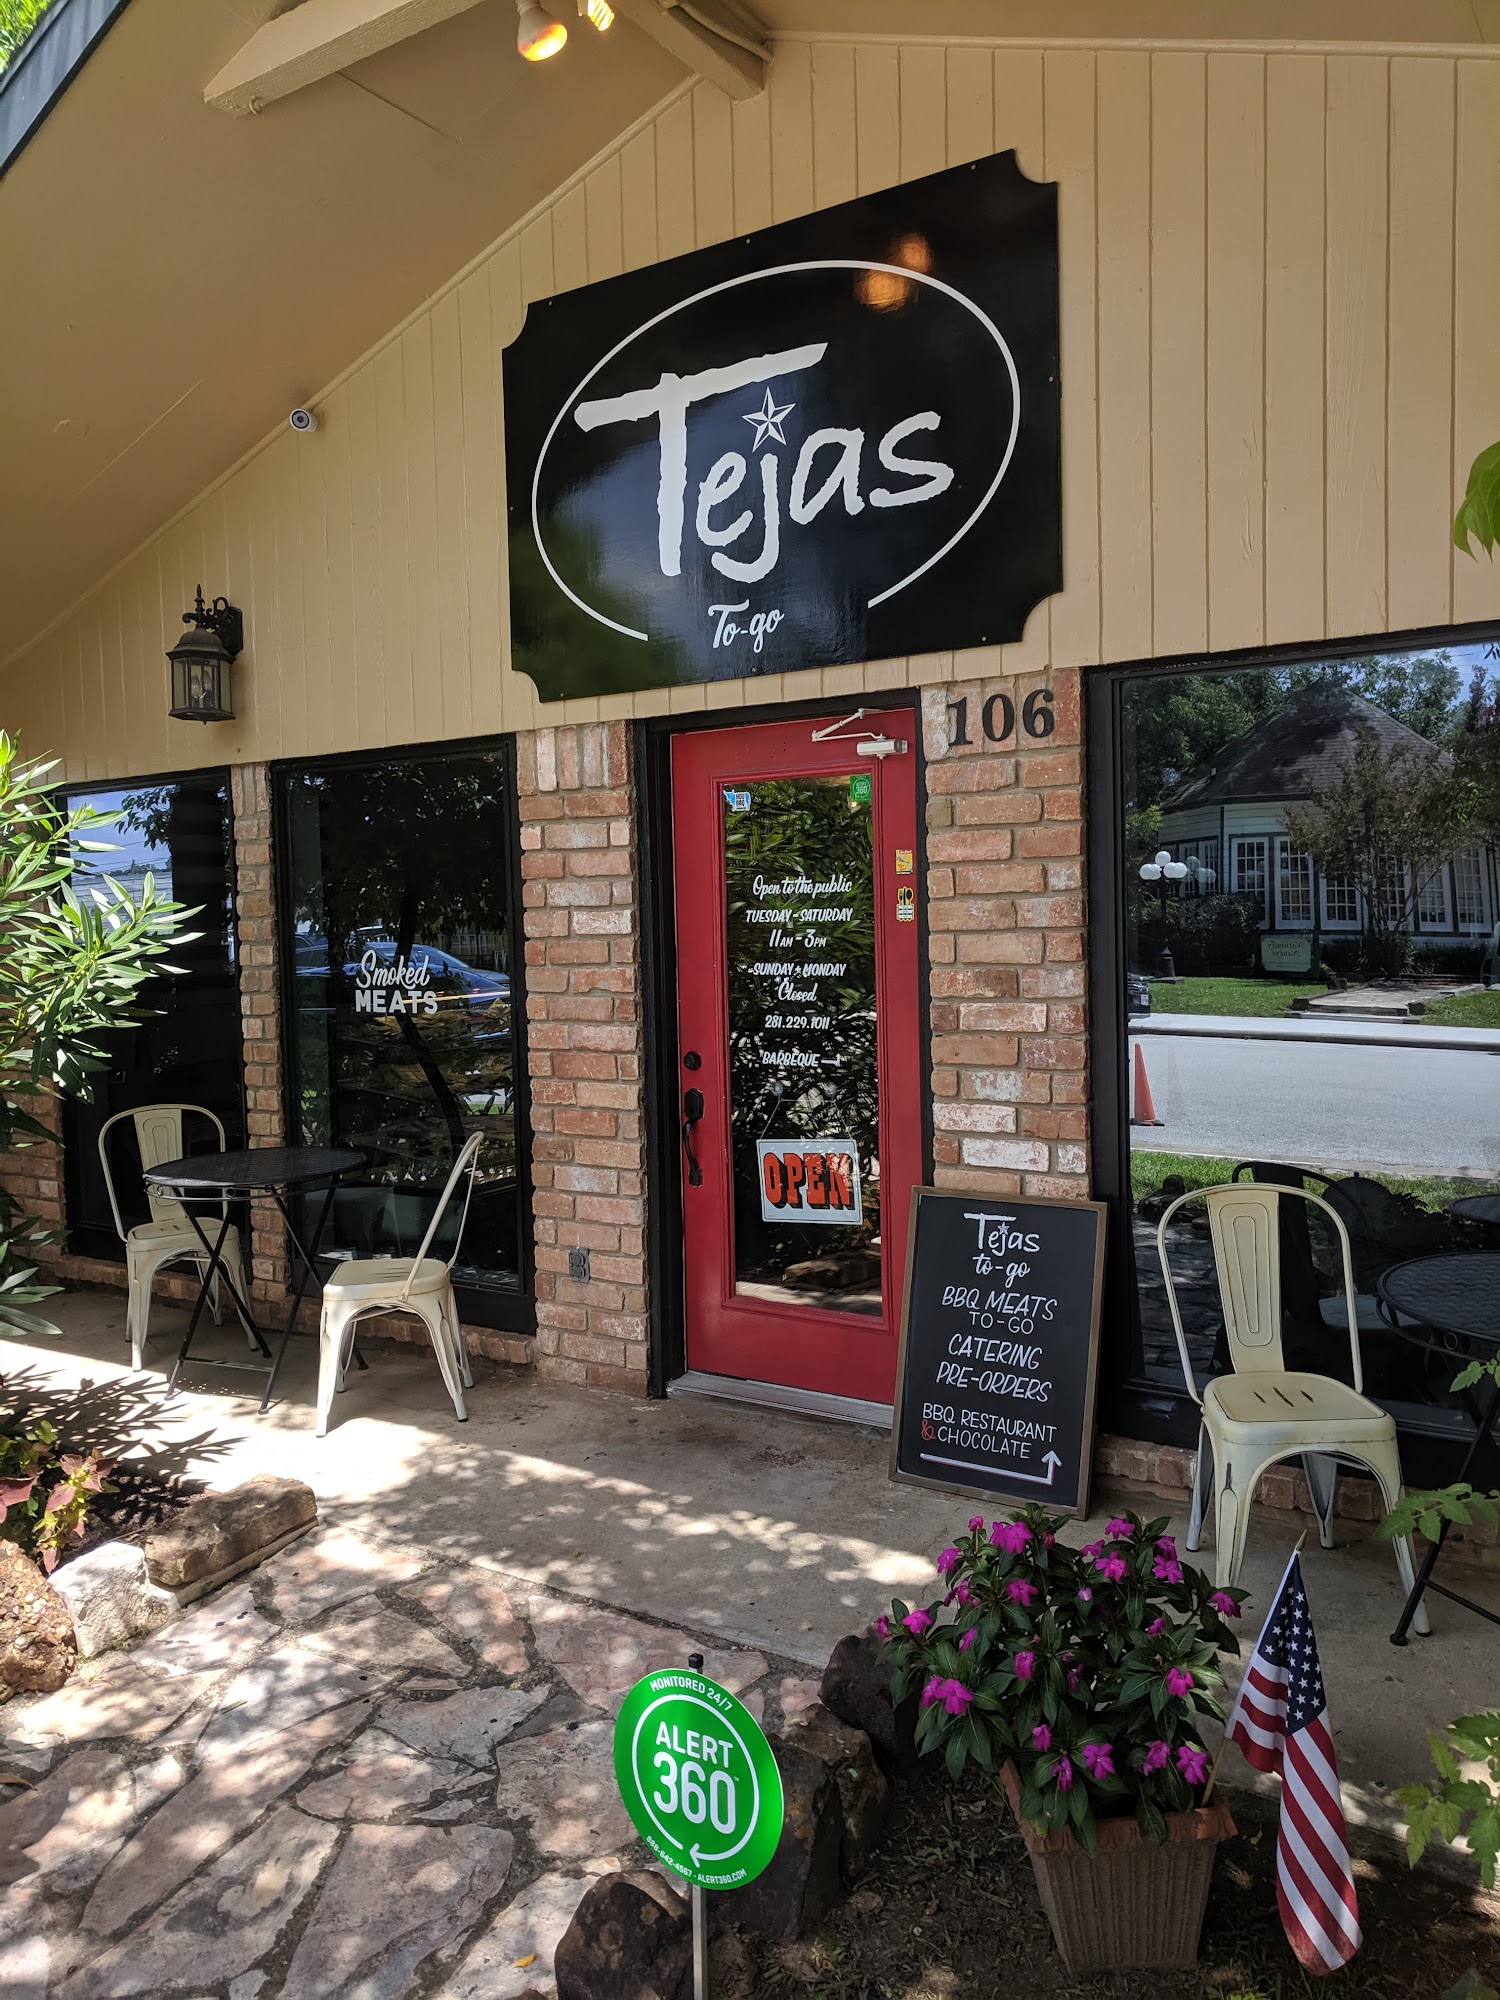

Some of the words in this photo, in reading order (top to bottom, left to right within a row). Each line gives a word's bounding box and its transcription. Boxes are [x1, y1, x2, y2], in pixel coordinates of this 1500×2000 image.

[574, 342, 955, 584] Tejas
[707, 599, 785, 653] To-go
[946, 688, 1055, 746] 106
[753, 875, 781, 900] Open
[781, 876, 795, 894] to
[795, 875, 813, 894] the
[812, 874, 852, 899] public
[746, 909, 792, 922] TUESDAY
[799, 908, 853, 921] SATURDAY
[804, 929, 827, 947] 3PM
[356, 949, 431, 990] Smoked
[753, 963, 795, 975] SUNDAY
[802, 963, 847, 976] MONDAY
[355, 989, 439, 1015] MEATS
[778, 982, 818, 1001] Closed
[764, 1015, 831, 1029] 281.229.1011
[762, 1052, 820, 1068] BARBEQUE
[763, 1152, 855, 1210] OPEN
[963, 1212, 1041, 1257] Tejas
[972, 1252, 1031, 1288] to-go
[941, 1285, 980, 1310] BBQ
[984, 1290, 1058, 1321] MEATS
[948, 1333, 1043, 1370] CATERING
[935, 1361, 1052, 1402] PRE-ORDERS
[921, 1419, 936, 1440] &
[937, 1426, 1032, 1459] CHOCOLATE
[922, 1402, 956, 1424] BBQ
[960, 1409, 1058, 1443] RESTAURANT
[649, 1675, 706, 1693] MONITORED
[706, 1687, 733, 1711] 24/7
[655, 1720, 734, 1768] ALERT
[653, 1751, 736, 1835] 360
[697, 1868, 747, 1885] ALERT360.COM
